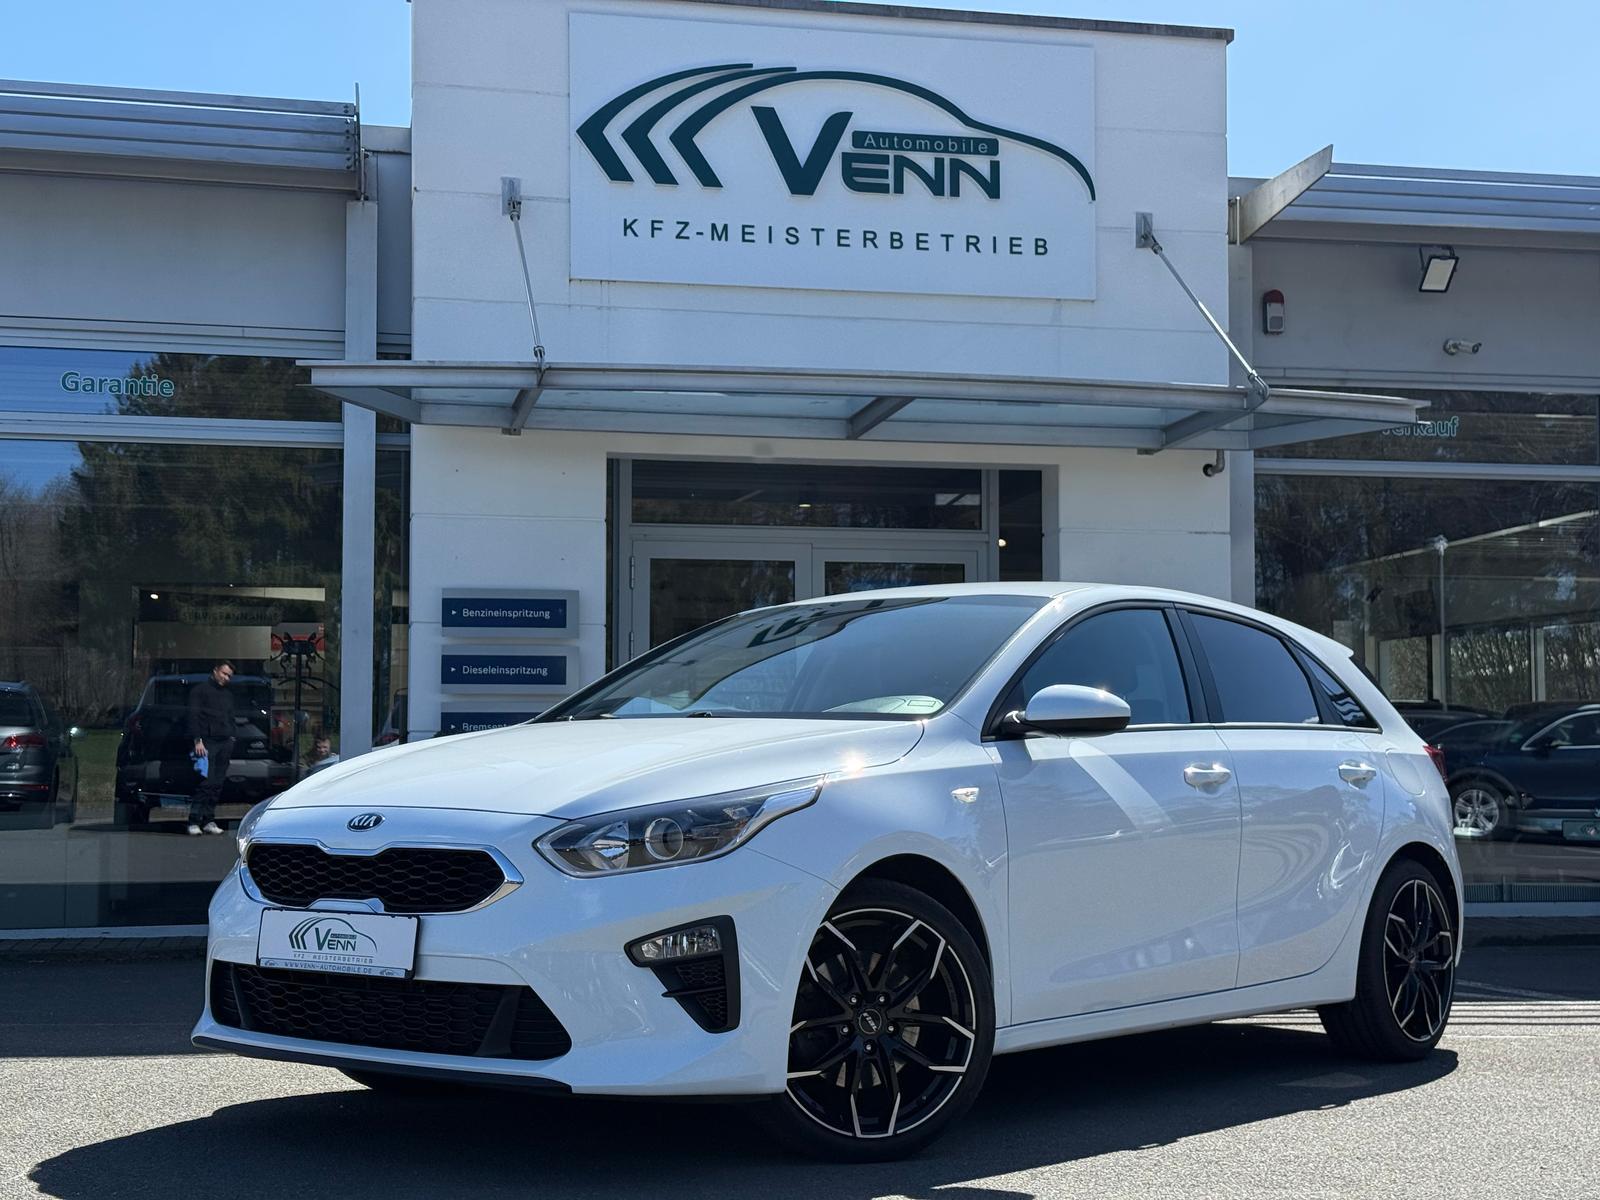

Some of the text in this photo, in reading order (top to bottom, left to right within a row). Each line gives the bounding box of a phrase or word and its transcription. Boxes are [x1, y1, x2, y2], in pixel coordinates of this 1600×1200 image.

[750, 105, 1001, 200] VENN
[863, 133, 990, 154] Automobile
[622, 217, 1050, 257] KFZ-MEISTERBETRIEB
[61, 370, 175, 398] Garantie
[462, 608, 551, 619] Benzineinspritzung
[462, 665, 549, 676] Dieseleinspritzung
[350, 815, 377, 827] KIA
[314, 927, 357, 951] VENN
